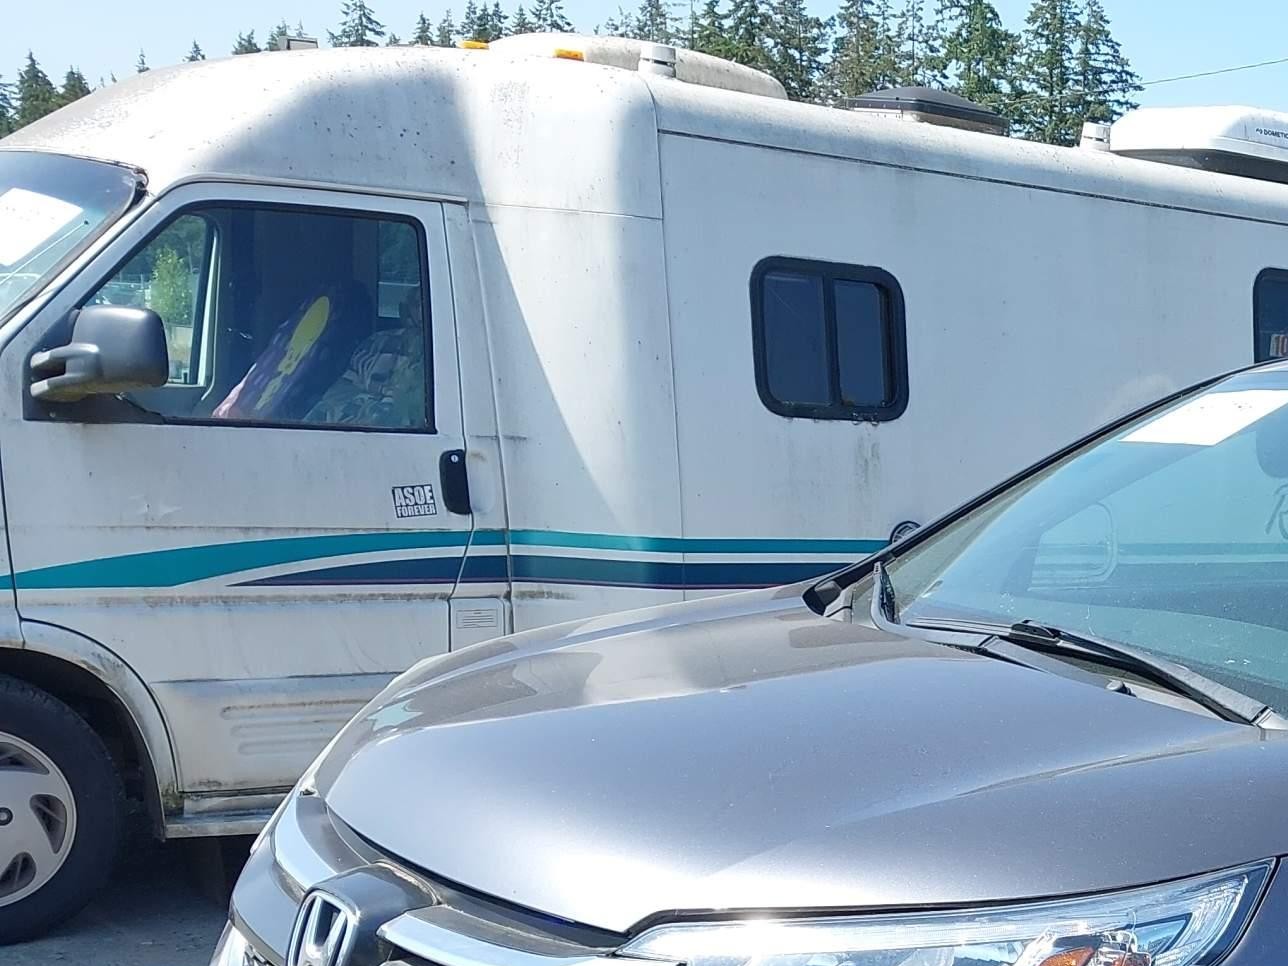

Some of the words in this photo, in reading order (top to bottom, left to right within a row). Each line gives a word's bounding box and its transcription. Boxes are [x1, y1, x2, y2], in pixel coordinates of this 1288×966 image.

[1263, 128, 1288, 139] DOMETIC
[394, 485, 434, 506] ASOE
[396, 503, 436, 517] FOREVER
